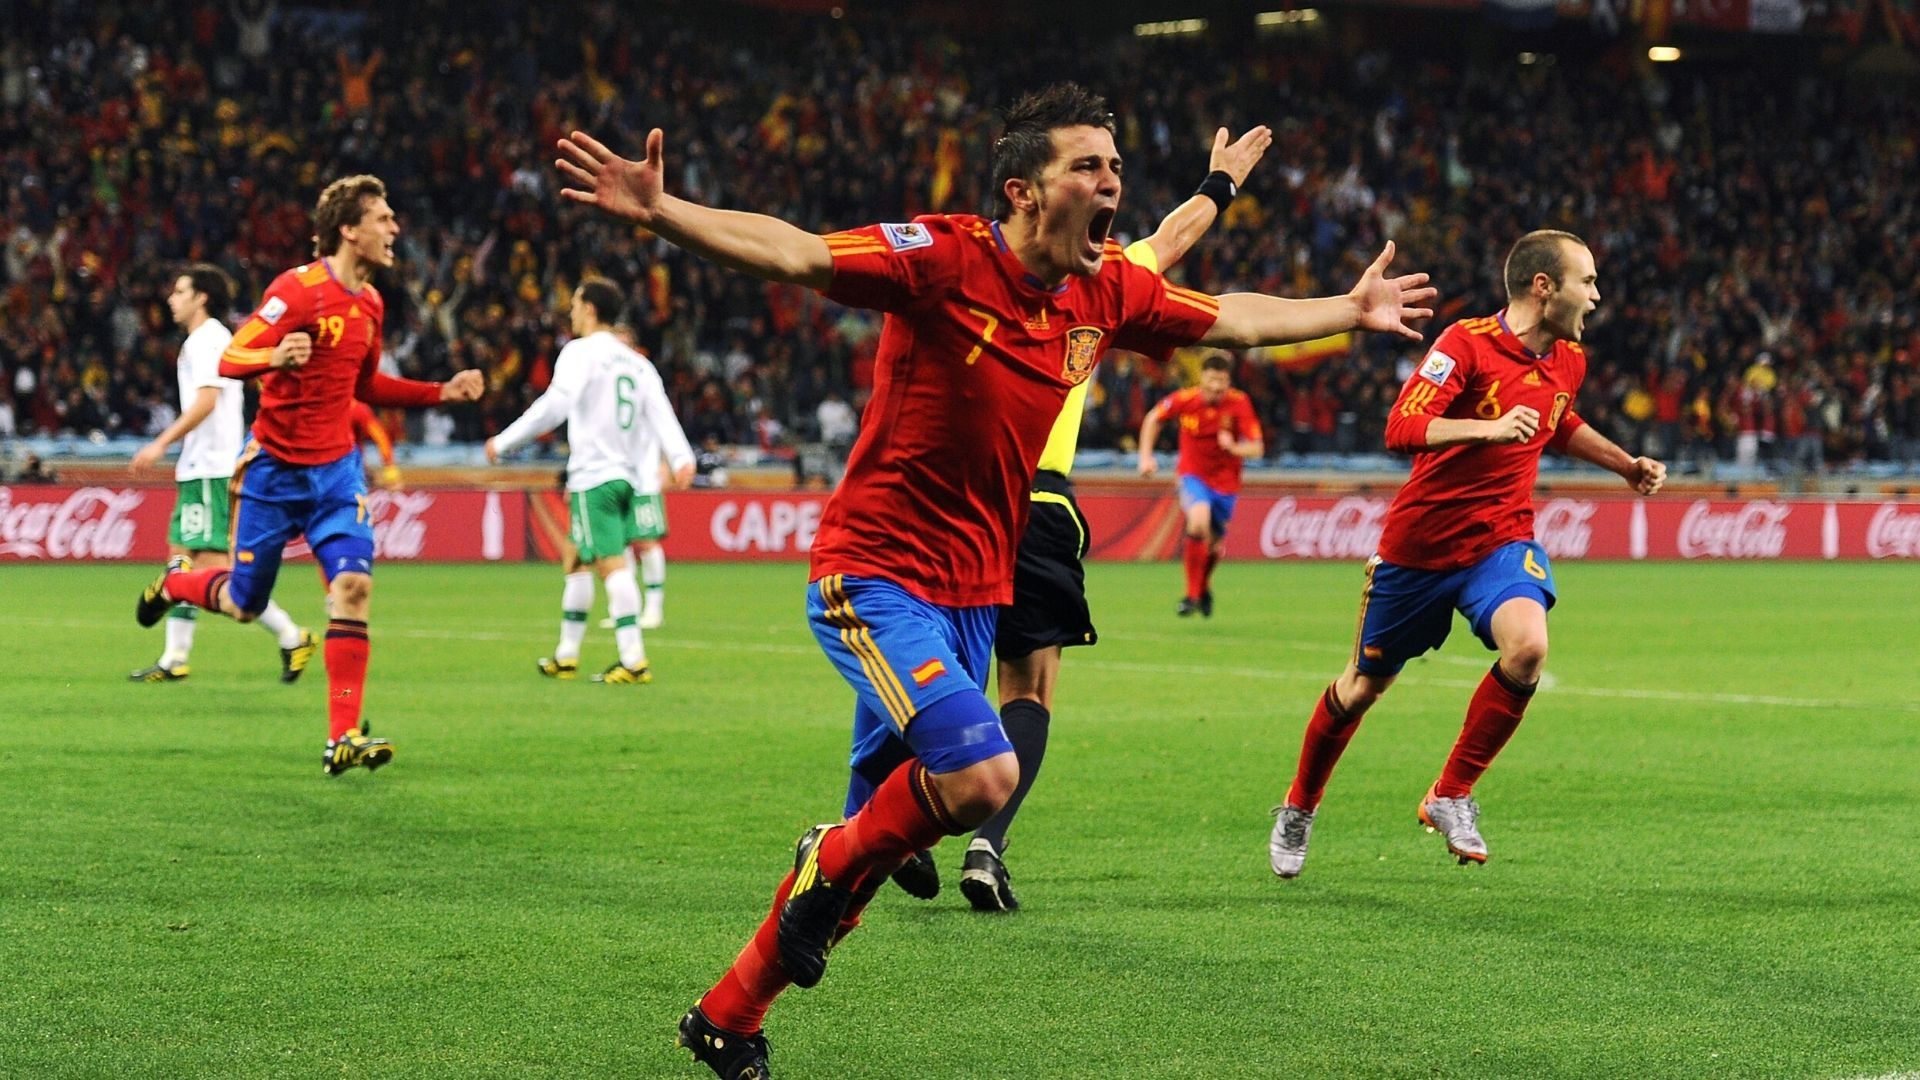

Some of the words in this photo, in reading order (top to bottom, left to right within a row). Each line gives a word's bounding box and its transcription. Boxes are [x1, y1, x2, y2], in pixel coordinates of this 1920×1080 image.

[317, 315, 344, 348] 19
[966, 307, 998, 365] 7
[615, 374, 636, 431] 6
[1475, 379, 1500, 420] 6
[711, 503, 822, 551] CAPE
[1523, 549, 1546, 580] 6
